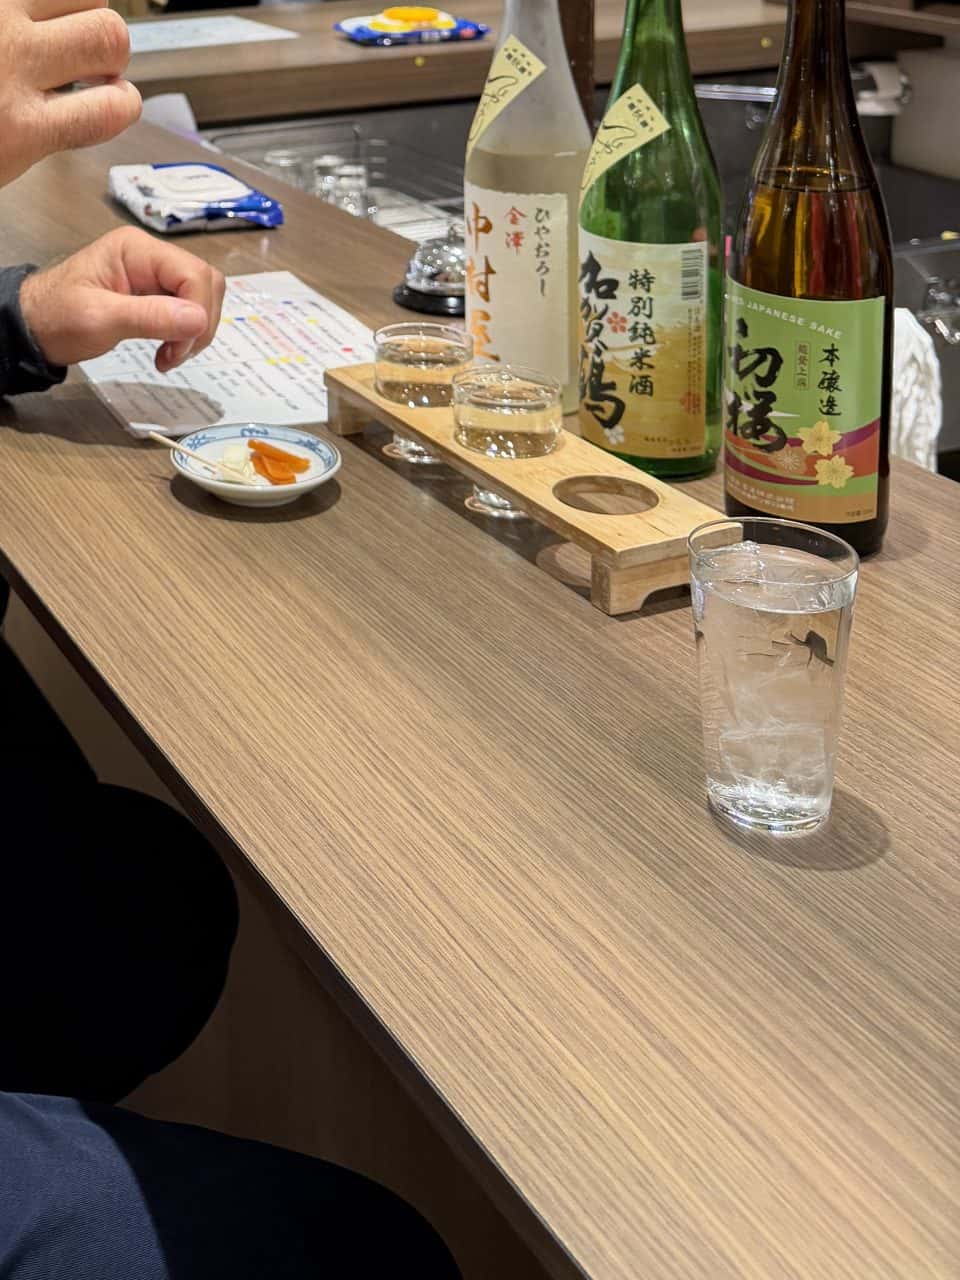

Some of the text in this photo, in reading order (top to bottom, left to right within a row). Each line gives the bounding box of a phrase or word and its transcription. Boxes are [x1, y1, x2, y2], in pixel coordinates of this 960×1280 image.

[534, 207, 551, 297] ひやおろし
[628, 268, 656, 397] 特別純米酒
[747, 300, 844, 340] JAPANESE SAKE
[817, 343, 843, 417] 本醸造
